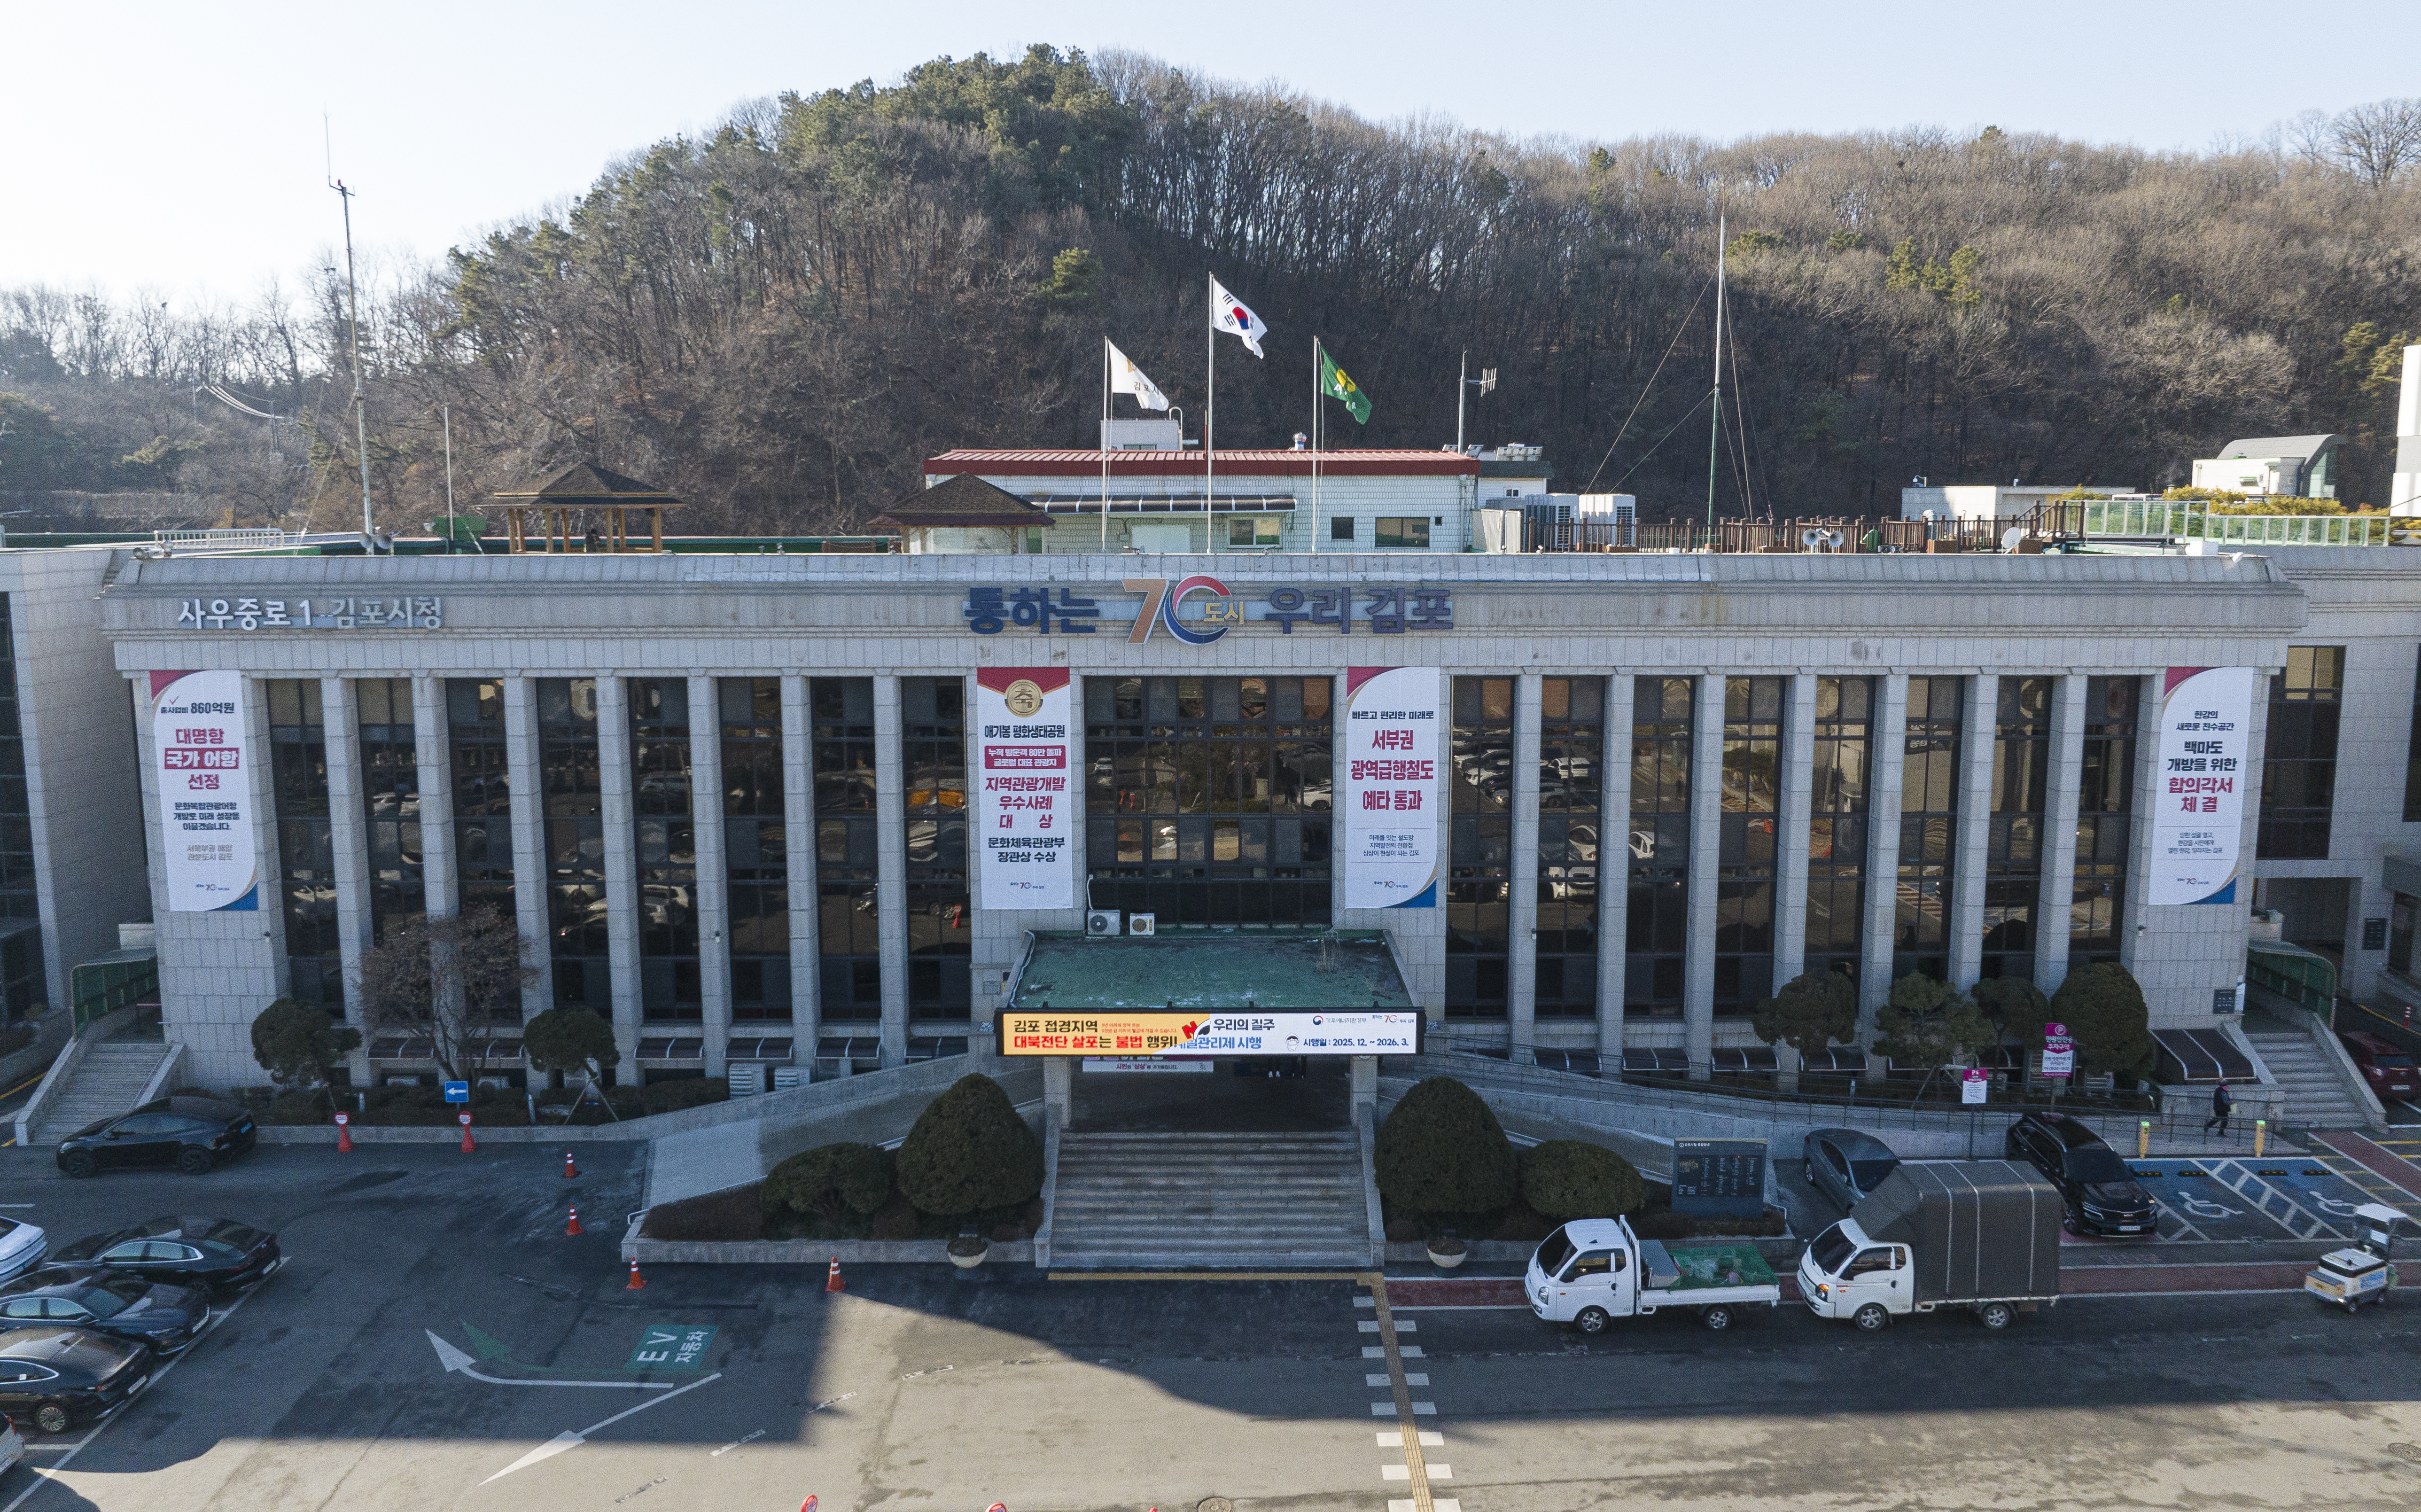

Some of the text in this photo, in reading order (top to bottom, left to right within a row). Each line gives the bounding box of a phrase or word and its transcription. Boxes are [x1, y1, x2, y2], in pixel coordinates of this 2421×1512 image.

[178, 597, 442, 631] 사우중로 1 김포시청
[965, 587, 1099, 635] 통하는
[1202, 602, 1245, 624] 도시
[1265, 587, 1351, 635] 우리
[1365, 587, 1453, 635] 김포
[1014, 688, 1034, 709] 축
[191, 702, 235, 714] 860억원
[1352, 711, 1434, 719] 빠르고 편리한 미래로
[984, 725, 1065, 738] 애기봉 평화생태공원
[2203, 722, 2234, 731] 친수공간
[176, 728, 225, 744] 대명항
[1372, 730, 1413, 750] 서부권
[2184, 741, 2223, 754] 백마도
[166, 751, 239, 767] 국가 어항
[2167, 758, 2237, 771] 개방을 위한
[1351, 760, 1433, 780] 광역급행철도
[188, 774, 220, 790] 선정
[985, 777, 1066, 791] 지역관광개발
[2169, 777, 2233, 793] 합의각서
[175, 802, 238, 811] 문화복합관광어항
[999, 795, 1053, 810] 우수사례
[1362, 790, 1422, 810] 예타 통과
[2180, 796, 2218, 812] 체 결
[183, 822, 232, 831] 이끌겠습니다.
[999, 814, 1053, 828] 대 상
[988, 837, 1065, 848] 문화체육관광부
[998, 851, 1056, 862] 장관상 수상
[1014, 1020, 1098, 1033] 김포 접경지역
[1214, 1019, 1275, 1031] 우리의 질주
[1014, 1036, 1068, 1048] 대북전단
[1072, 1036, 1112, 1048] 살포는
[1116, 1036, 1142, 1048] 불법
[1237, 1037, 1262, 1049] 시행
[1303, 1038, 1327, 1046] 시행일
[1401, 1038, 1409, 1046] 3.
[637, 1332, 678, 1362] EV
[674, 1330, 708, 1363] 자동차
